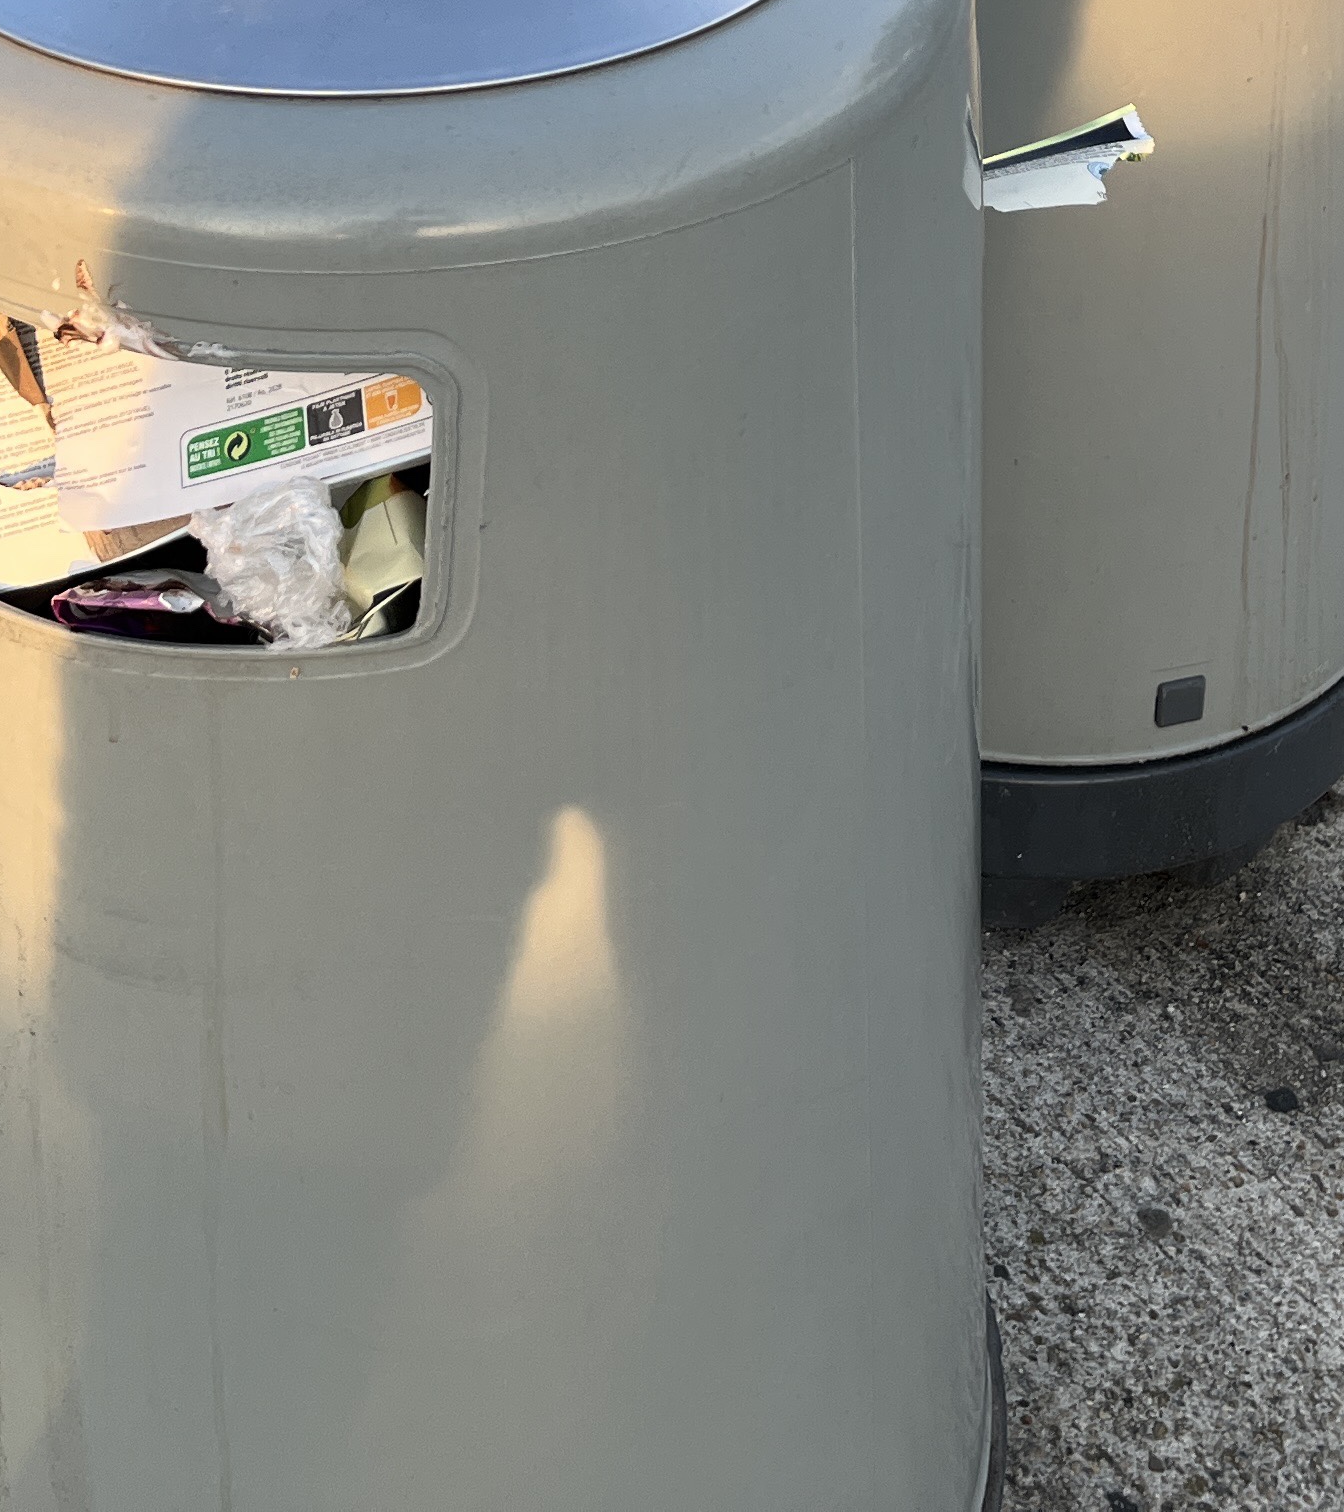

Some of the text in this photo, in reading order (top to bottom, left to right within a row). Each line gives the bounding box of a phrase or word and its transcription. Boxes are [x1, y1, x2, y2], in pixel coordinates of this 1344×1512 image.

[189, 437, 220, 453] PENSEZ
[189, 452, 201, 463] AU
[202, 448, 216, 459] TRI
